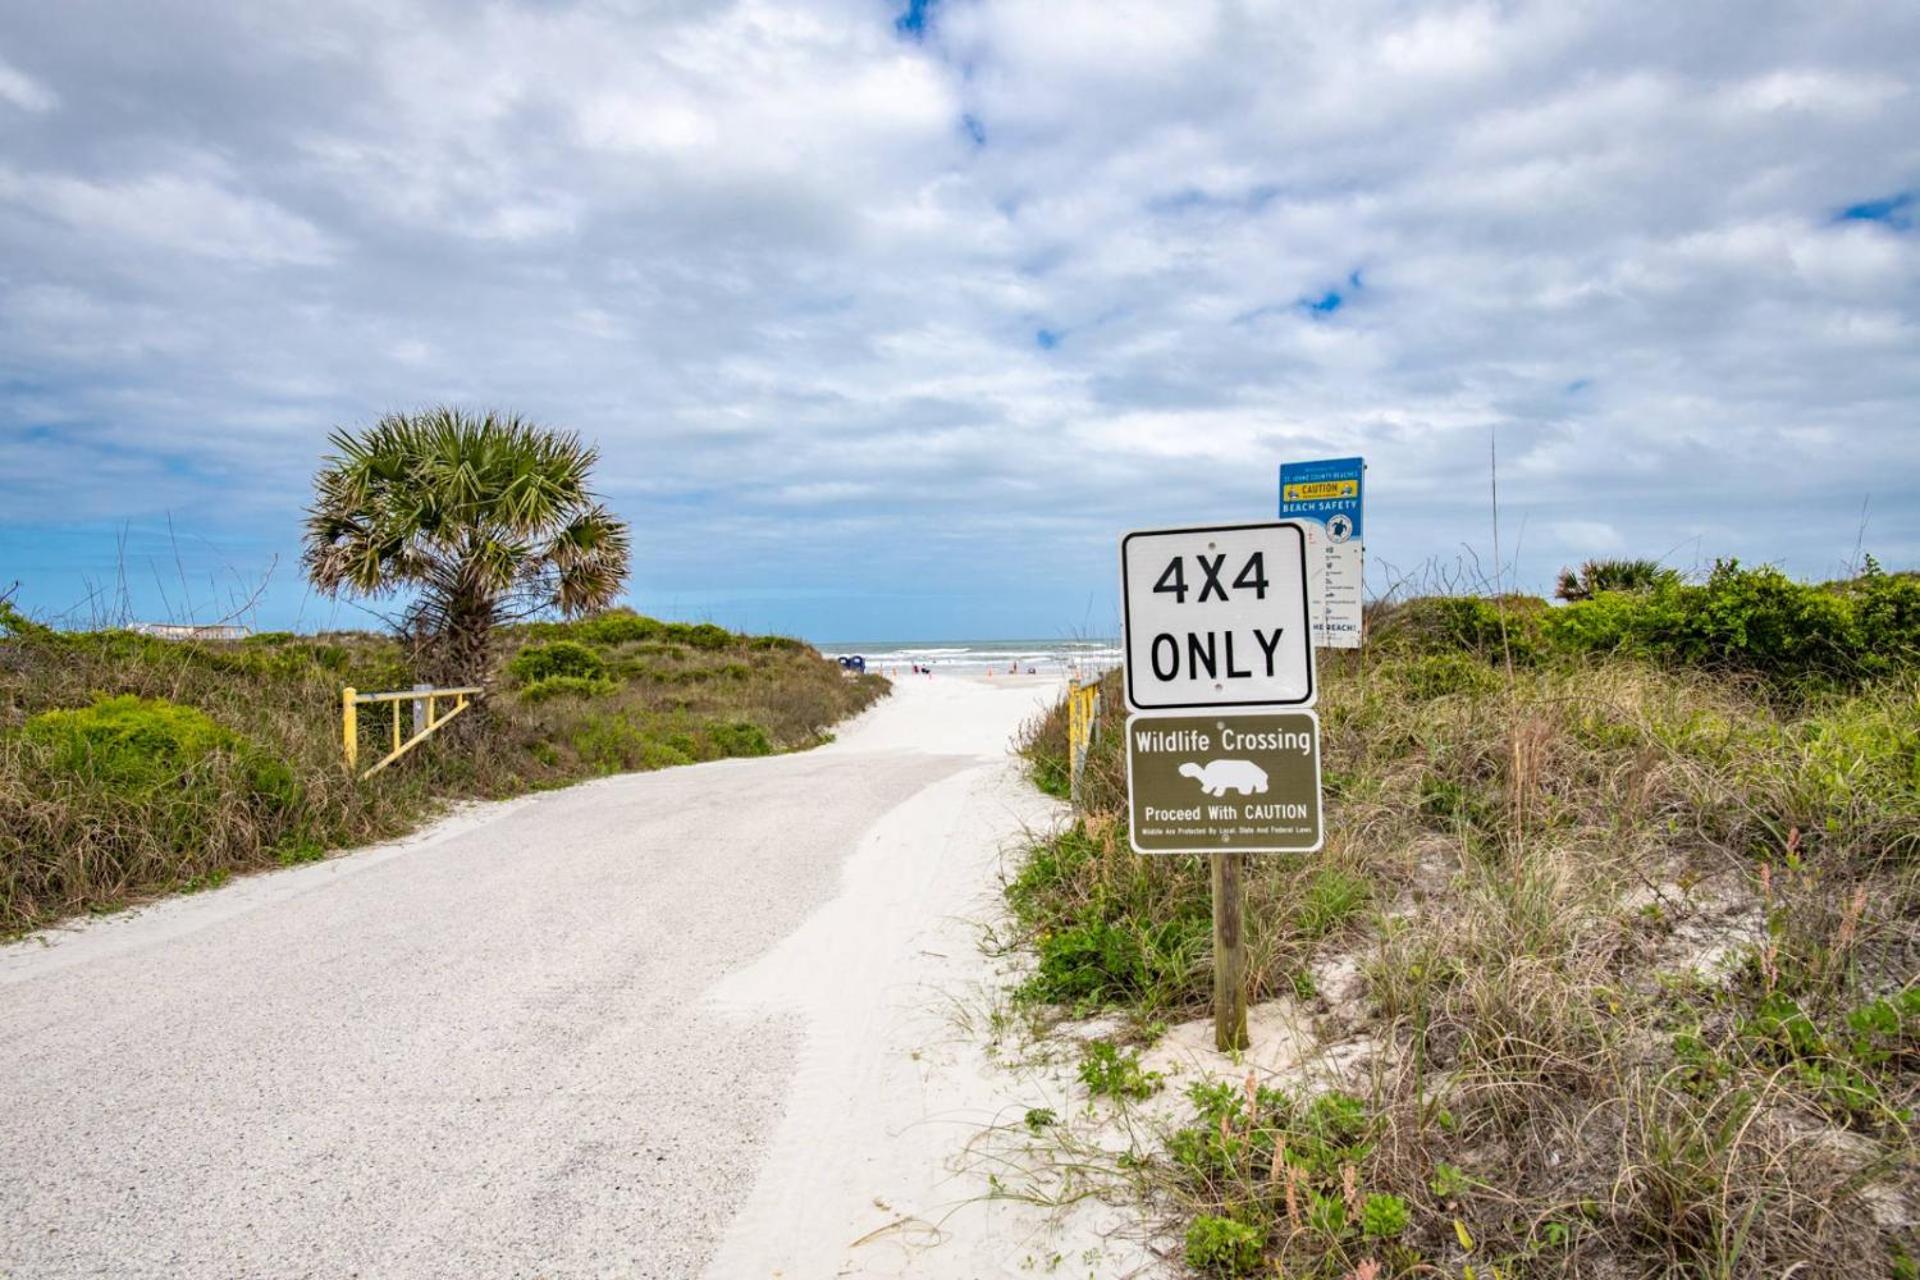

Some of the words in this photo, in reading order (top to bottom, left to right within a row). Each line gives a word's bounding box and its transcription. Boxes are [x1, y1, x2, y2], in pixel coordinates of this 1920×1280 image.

[1302, 483, 1338, 494] CAUTION
[1283, 504, 1315, 512] BEACH
[1319, 501, 1357, 510] SAFETY
[1153, 551, 1269, 604] 4X4
[1151, 628, 1284, 682] ONLY
[1136, 729, 1210, 753] Wildlife
[1221, 728, 1311, 755] Crossing
[1145, 806, 1201, 821] Proceed
[1208, 805, 1237, 820] With
[1245, 804, 1308, 820] CAUTION
[1208, 828, 1216, 836] By
[1256, 826, 1269, 834] And
[1271, 826, 1294, 834] Federal
[1295, 826, 1312, 834] Laws
